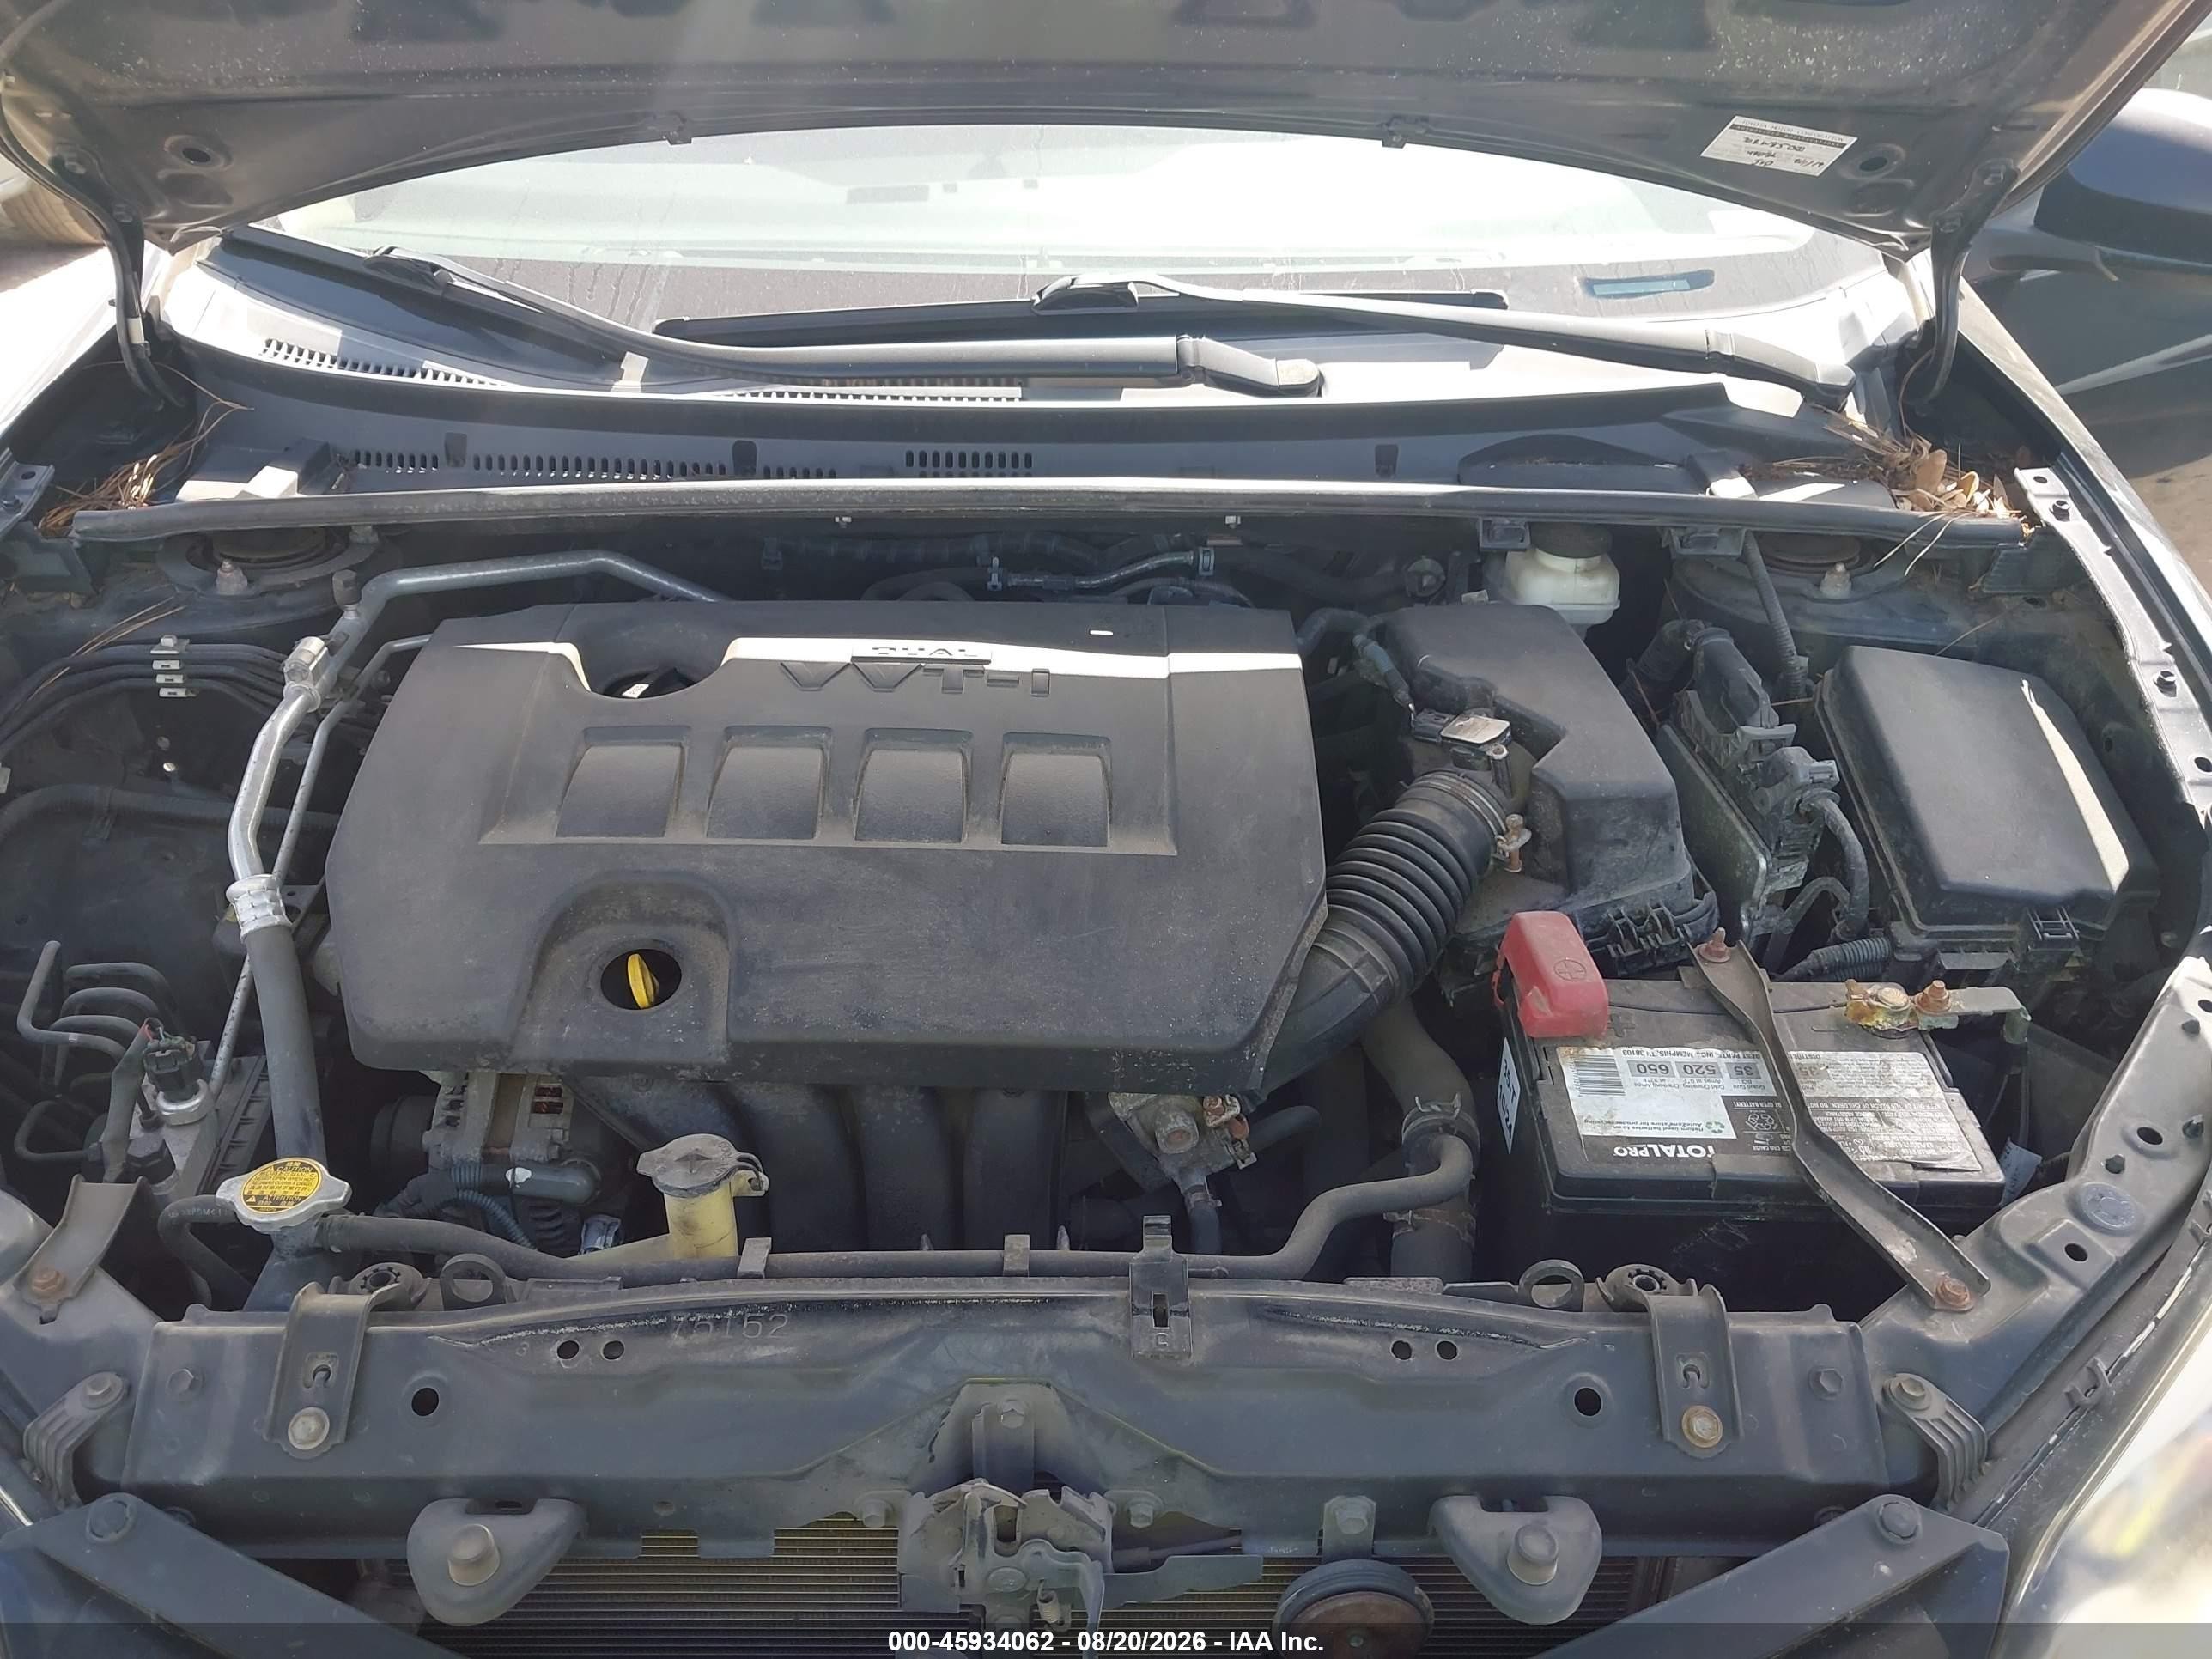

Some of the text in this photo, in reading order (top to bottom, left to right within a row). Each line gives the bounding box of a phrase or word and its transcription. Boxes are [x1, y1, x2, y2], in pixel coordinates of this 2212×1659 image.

[1637, 1063, 1669, 1074] 650
[1682, 1064, 1716, 1075] 520
[1734, 1066, 1753, 1076] 35
[1503, 1058, 1516, 1104] 35-T
[1613, 1143, 1715, 1158] TOTALPRO
